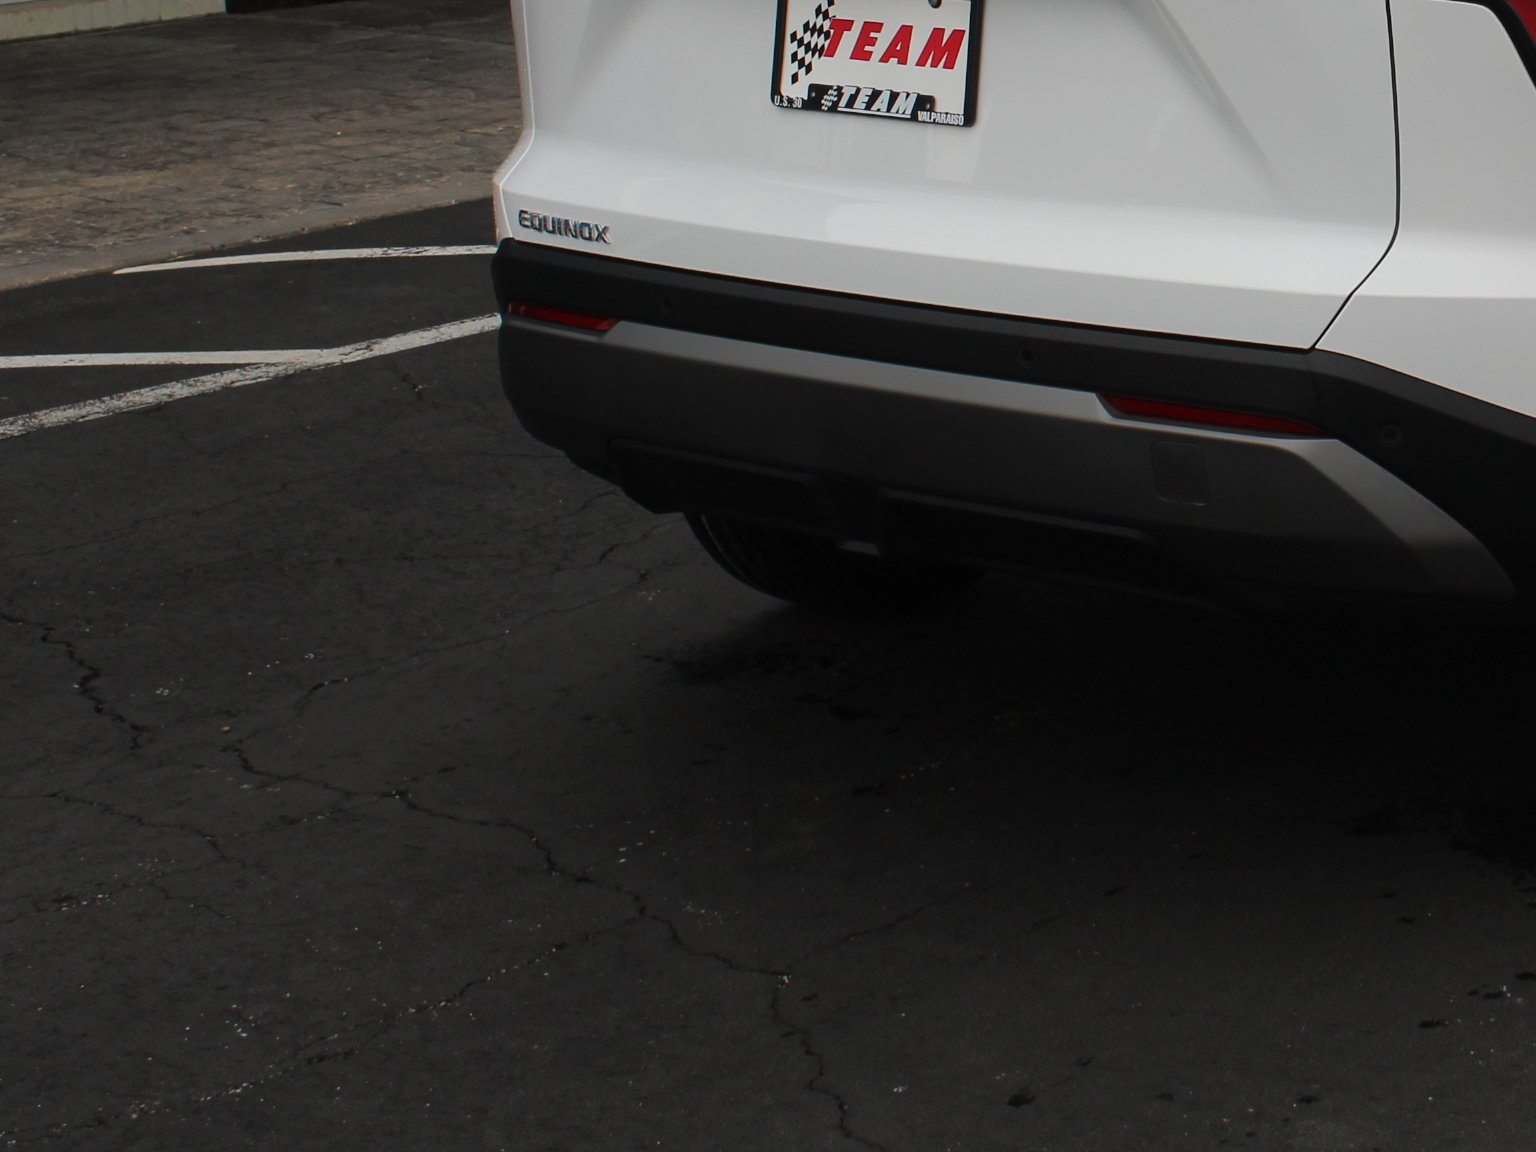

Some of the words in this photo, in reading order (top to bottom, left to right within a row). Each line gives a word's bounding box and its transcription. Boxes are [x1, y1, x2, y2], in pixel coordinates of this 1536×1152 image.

[823, 18, 966, 70] TEAM
[773, 95, 791, 108] U.S.
[792, 97, 803, 109] 30
[837, 85, 919, 115] TEAM
[917, 110, 965, 126] VALPARAISO
[518, 209, 612, 245] EQUINOX
